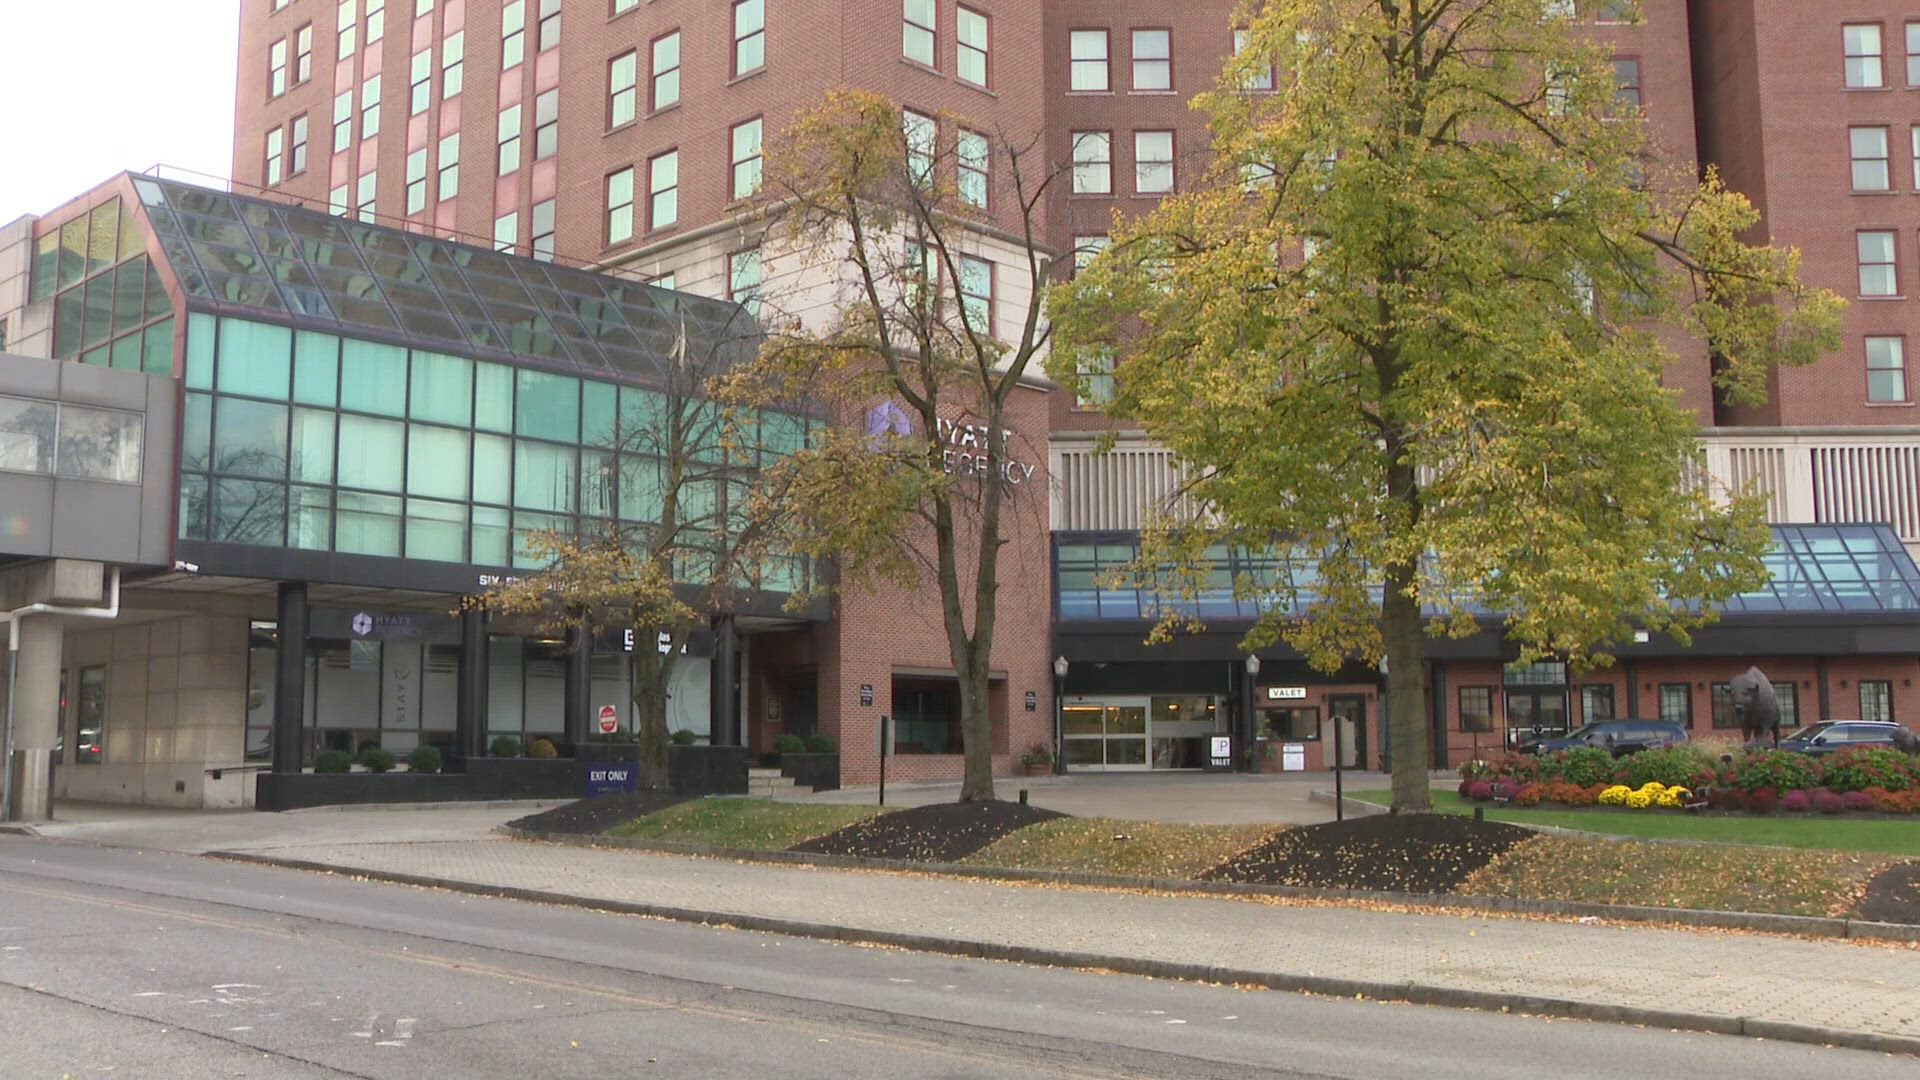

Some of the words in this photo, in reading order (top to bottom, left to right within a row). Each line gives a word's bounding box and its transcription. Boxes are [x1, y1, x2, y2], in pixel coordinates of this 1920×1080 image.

[376, 616, 411, 625] HYATT
[1273, 689, 1302, 697] VALET
[1210, 758, 1231, 767] VALET
[590, 770, 607, 781] EXIT
[608, 770, 629, 781] ONLY
